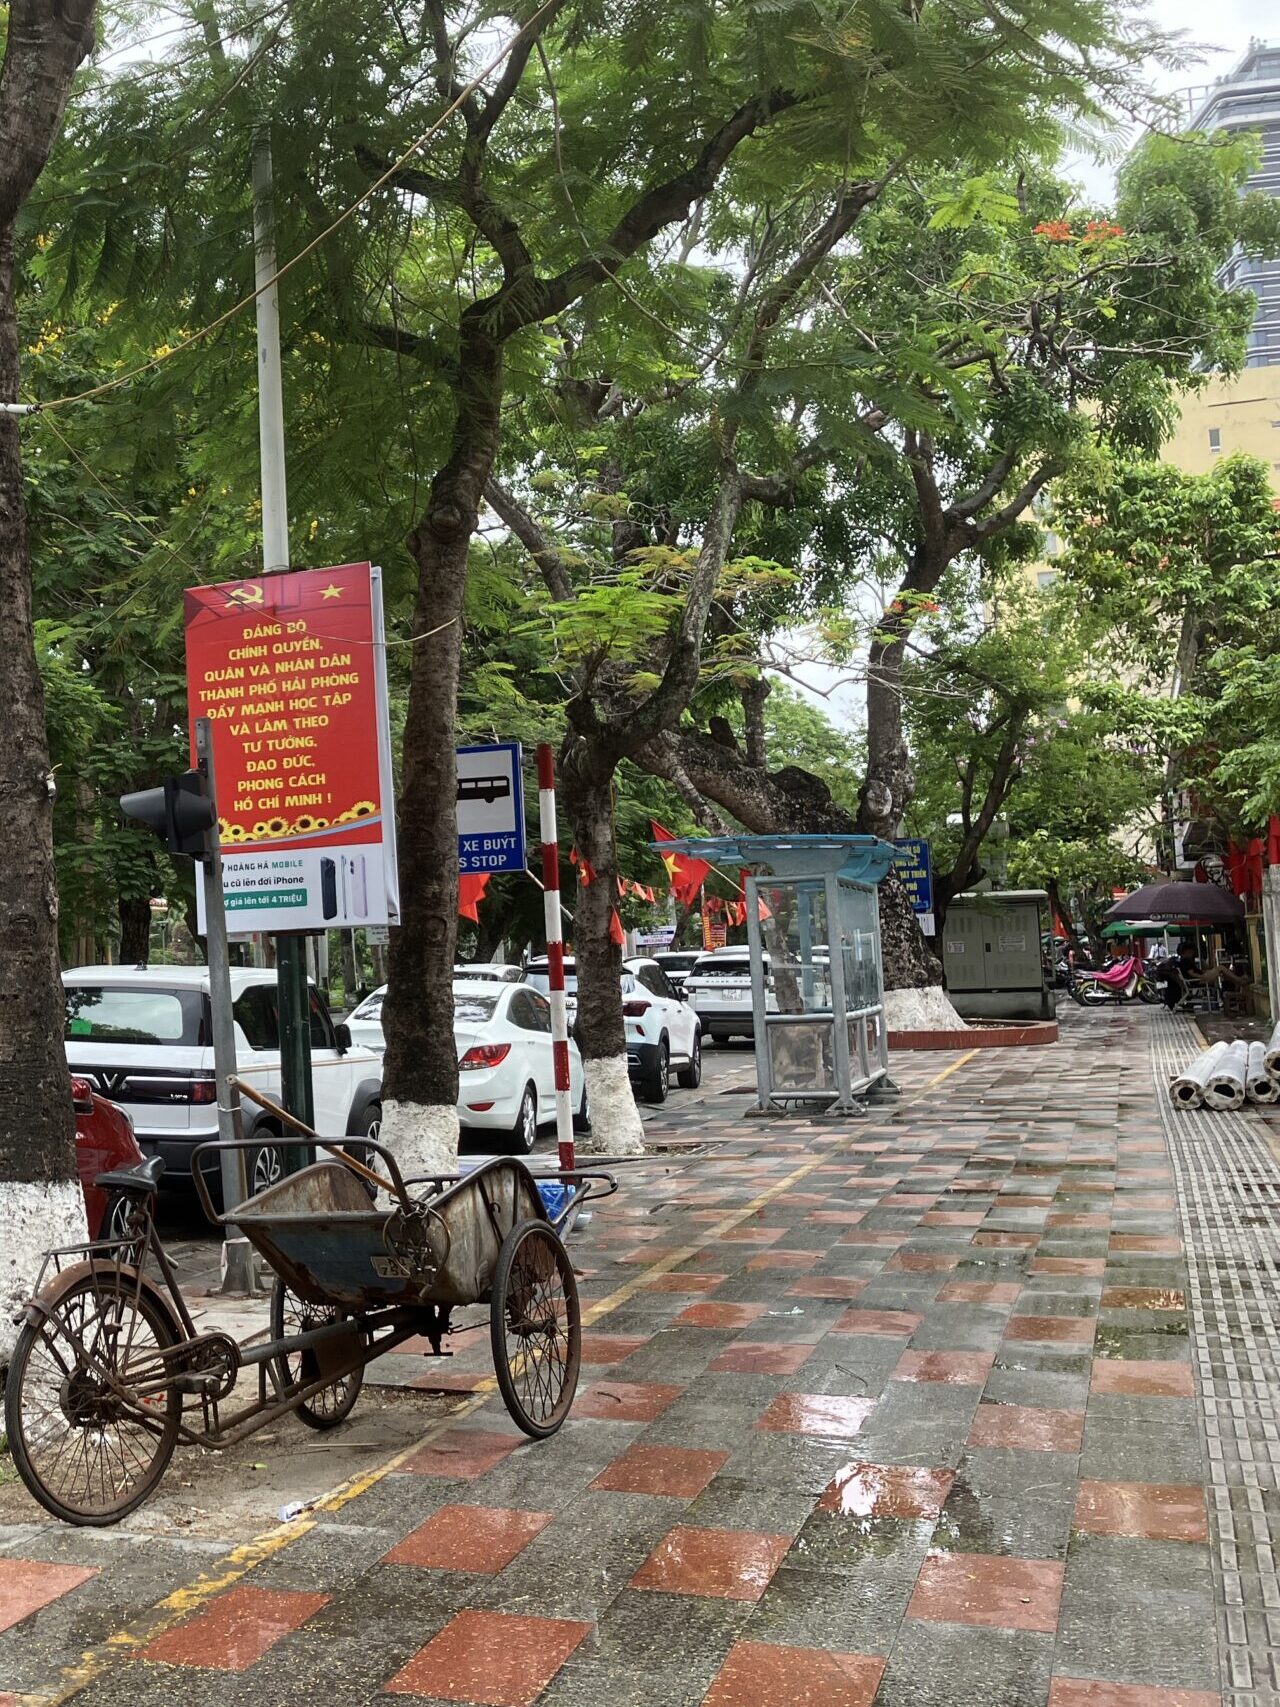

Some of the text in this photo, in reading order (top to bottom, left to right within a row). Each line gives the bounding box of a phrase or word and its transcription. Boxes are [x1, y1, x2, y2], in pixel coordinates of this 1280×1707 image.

[242, 618, 307, 639] ĐẢNG BỘ
[229, 644, 268, 661] CHÍNH
[204, 653, 351, 682] QUÂN VÀ NHÂN DÂN
[198, 672, 359, 702] THÀNH PHỐ HẢI PHÒNG
[206, 691, 352, 720] ĐẨY MẠNH HỌC TẬP
[229, 715, 329, 736] VÀ LÀM THEO
[242, 740, 262, 754] TƯ
[246, 758, 277, 773] ĐẠO
[237, 773, 326, 793] PHONG CÁCH
[233, 792, 332, 812] HỒ CHÍ MINH !
[463, 834, 517, 852] XE BUÝT
[227, 859, 304, 872] HOÀNG HÀ MOBILE
[471, 854, 507, 868] STOP
[230, 879, 241, 888] cũ
[242, 878, 256, 887] lên
[257, 877, 272, 886] đời
[273, 876, 304, 885] iPhone
[230, 898, 243, 907] giá
[244, 896, 257, 905] lên
[258, 895, 270, 904] tới
[278, 893, 303, 904] TRIỆU
